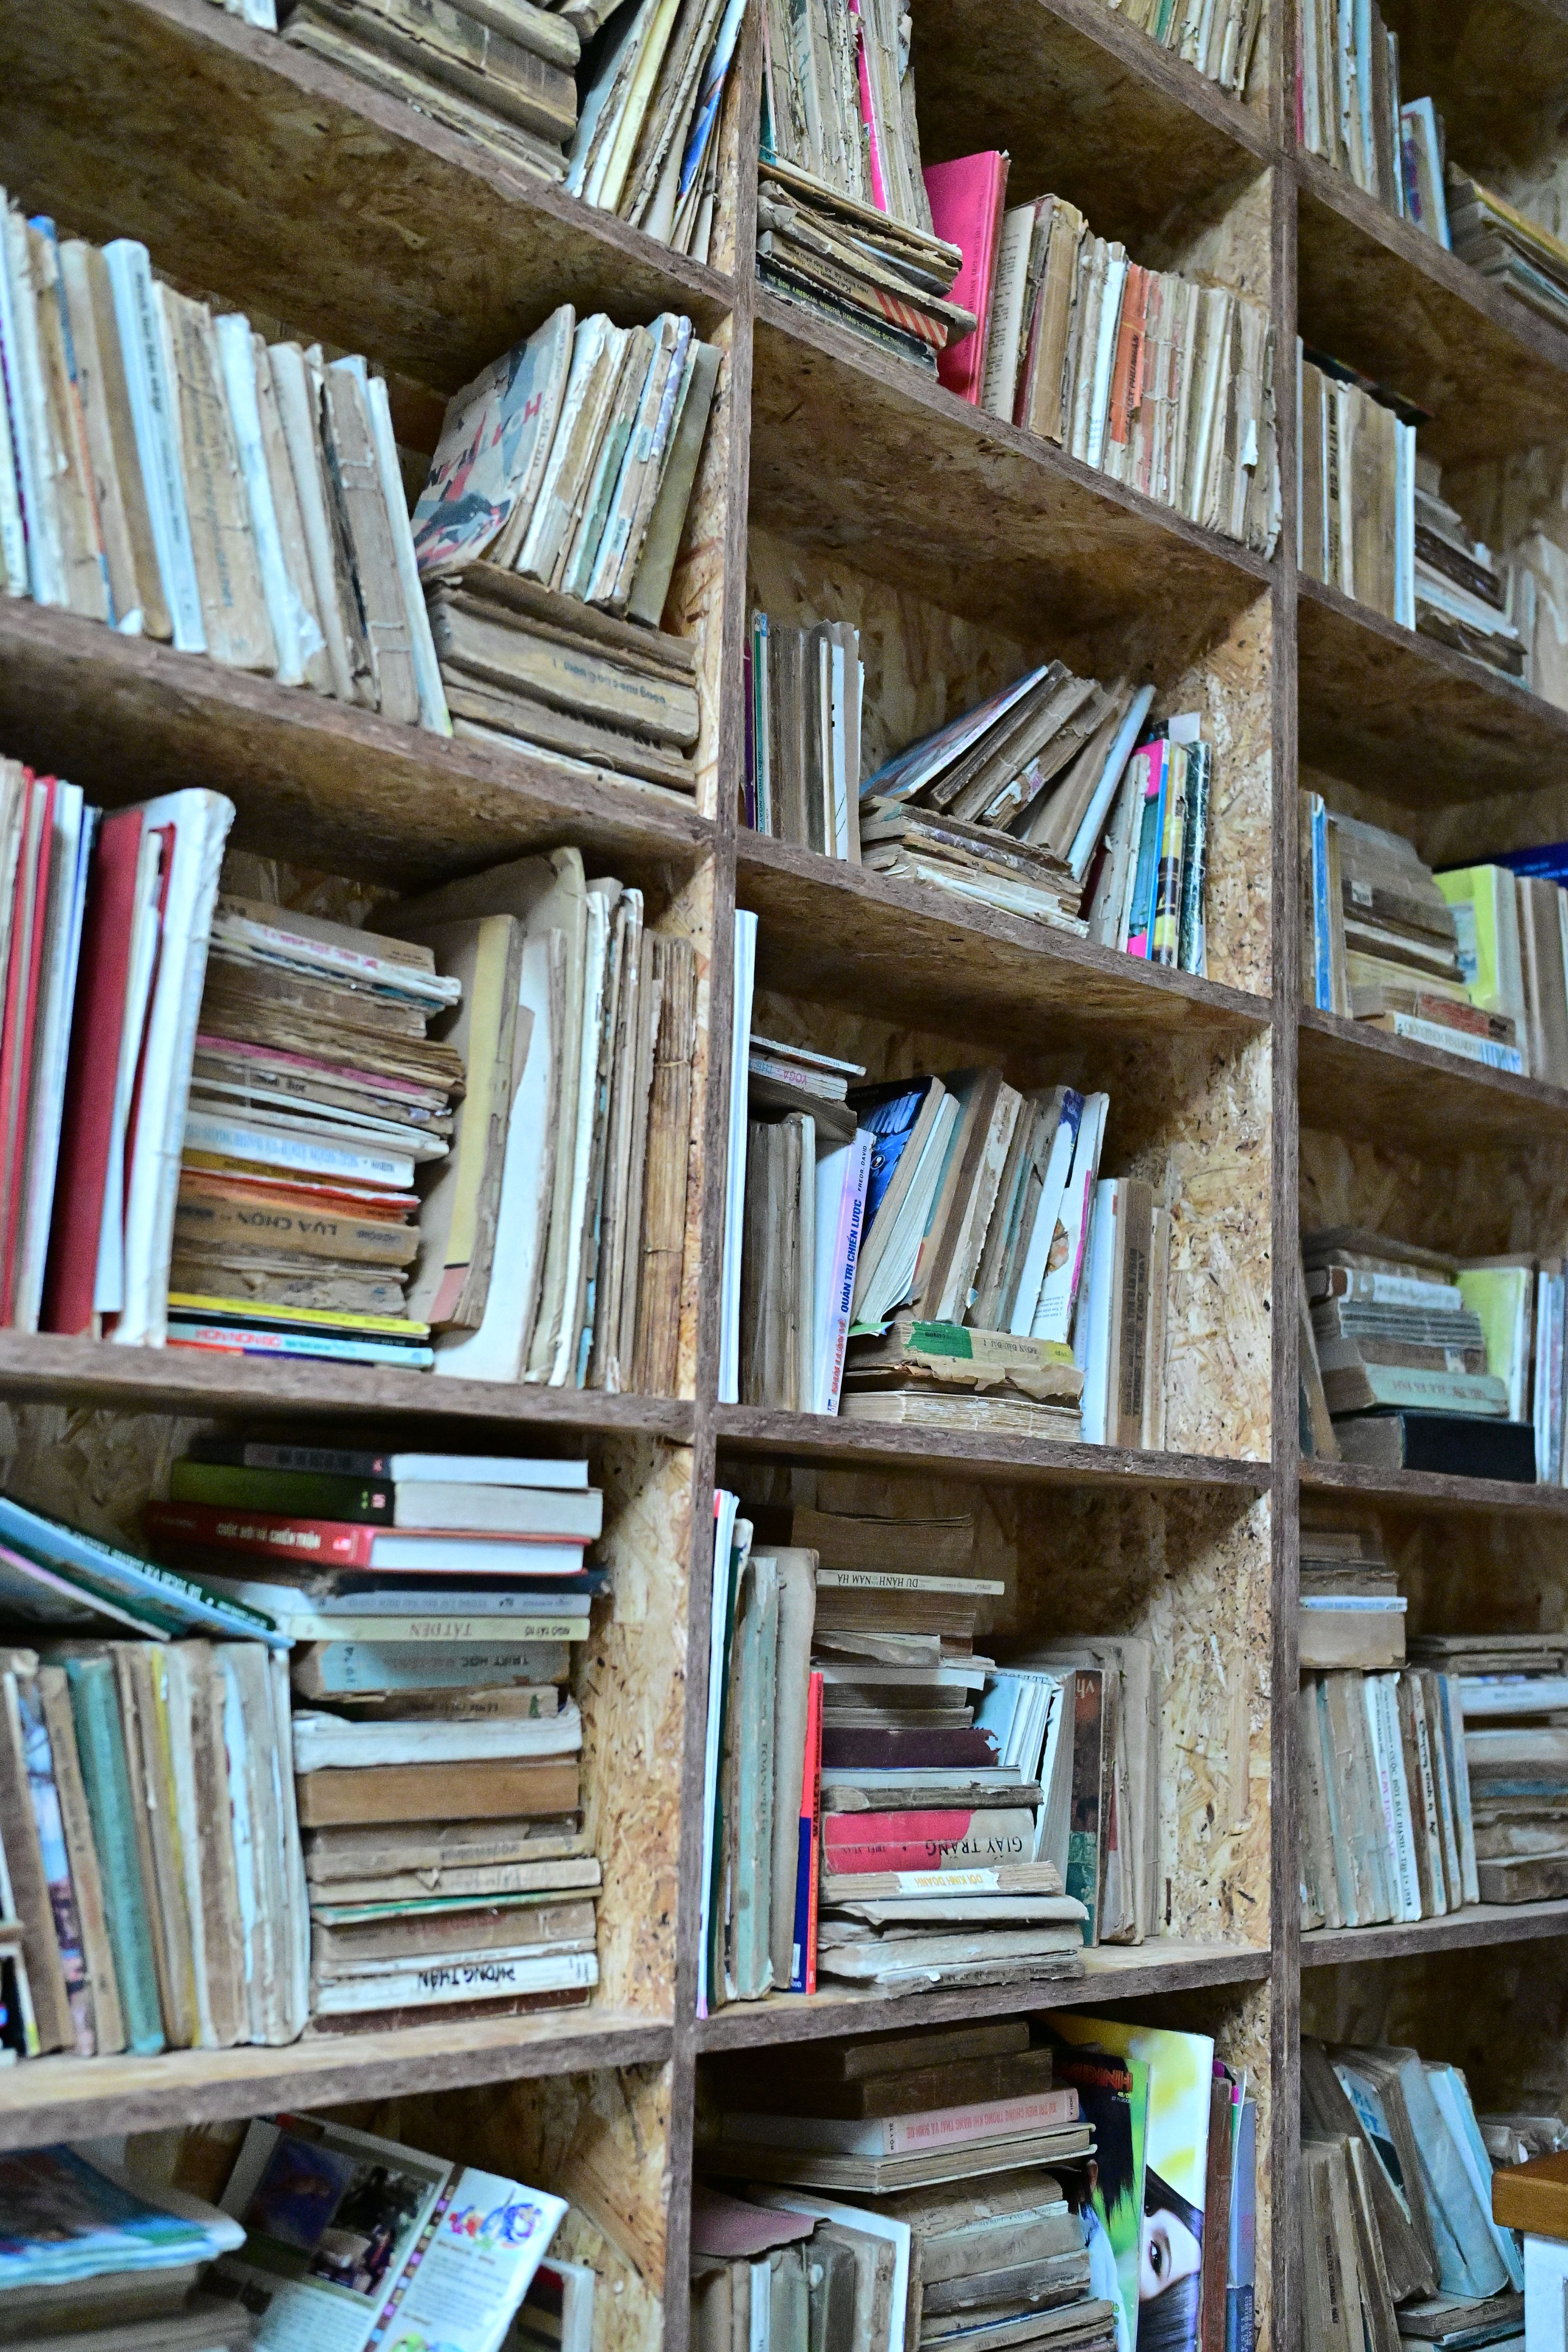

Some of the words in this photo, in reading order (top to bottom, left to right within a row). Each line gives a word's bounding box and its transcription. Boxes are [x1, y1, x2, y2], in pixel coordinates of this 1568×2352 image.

[860, 1145, 868, 1166] DAVID
[851, 1198, 865, 1228] LƯỢC
[846, 1228, 862, 1262] CHIẾN
[845, 1263, 857, 1281] TRỊ
[839, 1281, 854, 1314] QUẢN
[835, 1573, 849, 1586] HÀ
[851, 1573, 872, 1586] NAM
[878, 1574, 904, 1590] HÀNH
[906, 1577, 919, 1589] DU
[889, 2139, 895, 2150] BỘ
